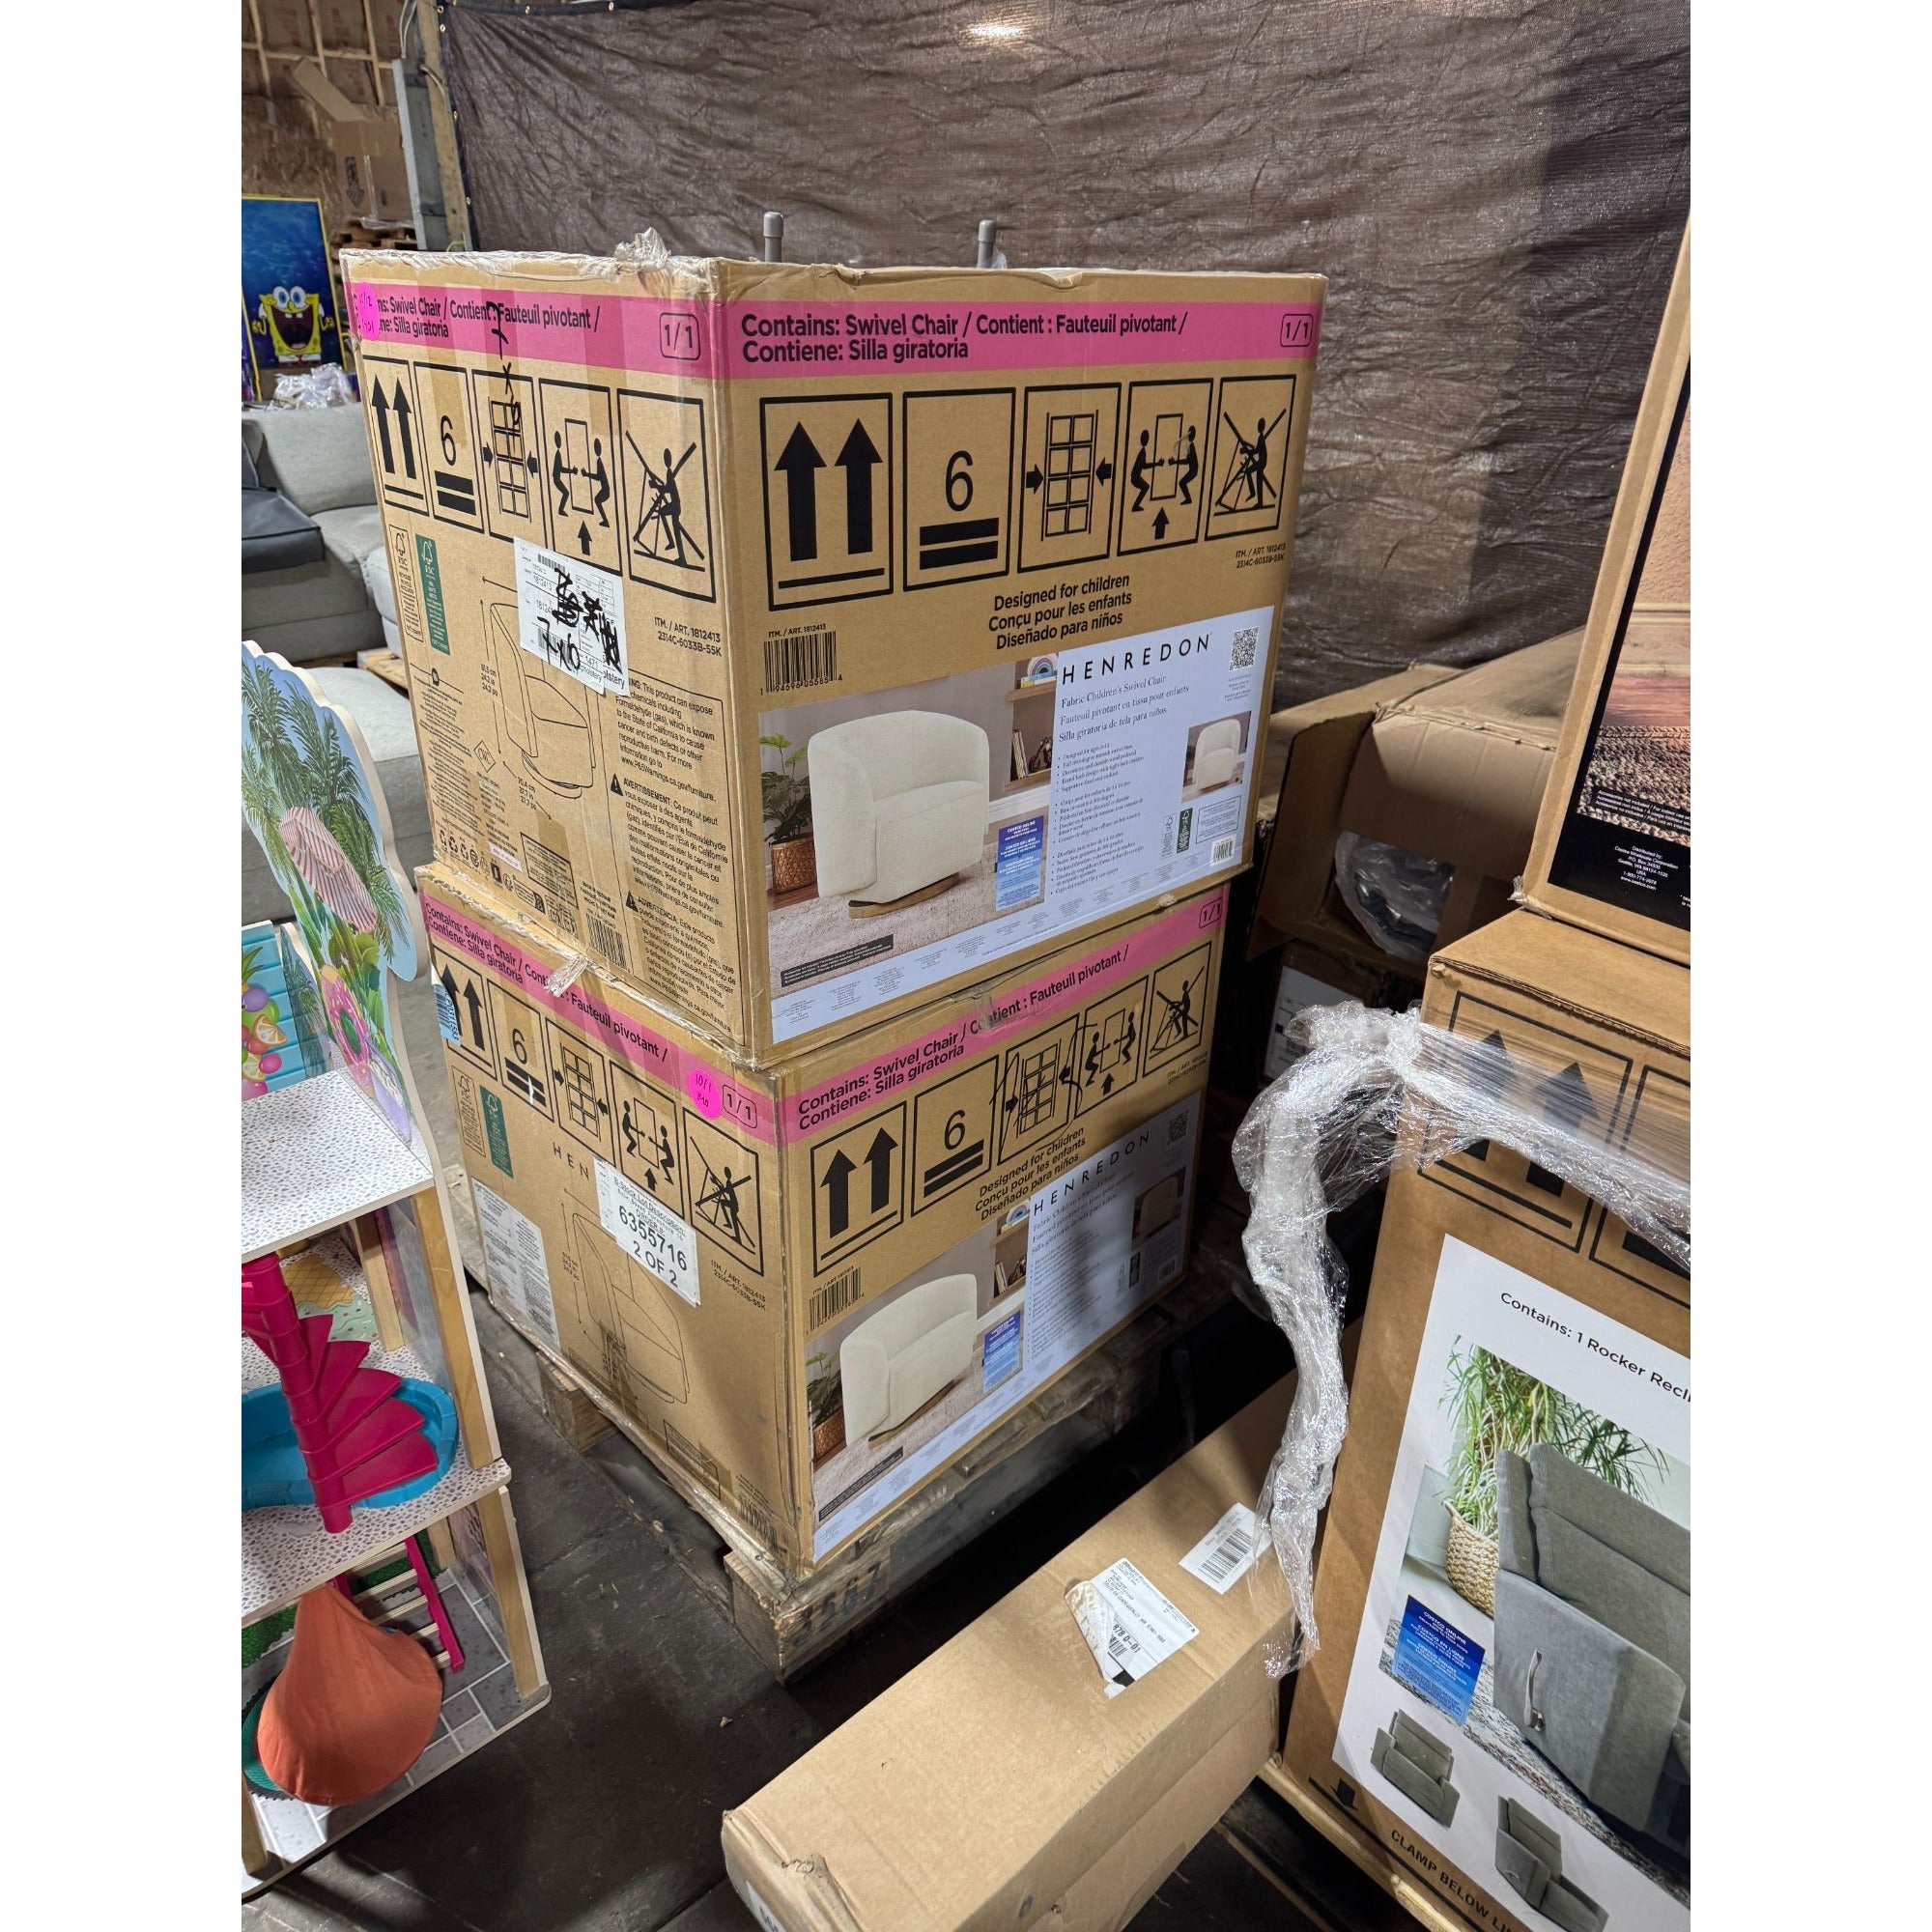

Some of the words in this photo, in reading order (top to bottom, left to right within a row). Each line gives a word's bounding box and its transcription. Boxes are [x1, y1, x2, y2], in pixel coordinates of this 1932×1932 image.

[389, 297, 417, 315] Swivel
[418, 298, 440, 317] Chair
[450, 299, 491, 321] Contient
[499, 302, 541, 325] Fauteuil
[543, 307, 591, 328] pivotant
[394, 317, 411, 333] Silla
[412, 320, 449, 338] giratoria
[742, 313, 839, 336] Contains:
[845, 313, 907, 336] Swivel
[912, 313, 958, 335] Chair
[977, 314, 1044, 334] Contient
[1056, 313, 1117, 334] Fauteuil
[1120, 313, 1177, 336] pivotant
[743, 340, 843, 363] Contiene:
[849, 338, 888, 361] Silla
[893, 338, 968, 364] giratoria
[946, 449, 974, 513] 6
[988, 611, 1031, 631] Conçu
[1035, 607, 1065, 627] pour
[1067, 601, 1085, 616] les
[1089, 592, 1132, 611] enfants
[994, 585, 1057, 611] Designed
[1060, 582, 1078, 598] for
[1081, 575, 1130, 595] children
[655, 616, 668, 630] ITM.
[673, 621, 690, 637] ART.
[691, 627, 722, 643] 1812413
[997, 625, 1058, 649] Diseñado
[1061, 620, 1088, 639] para
[1091, 611, 1122, 630] niños
[1062, 634, 1209, 685] HENREDON
[1061, 709, 1091, 725] Fauteuil
[1092, 703, 1121, 721] pivotant
[1132, 696, 1148, 708] tissu
[1149, 693, 1165, 705] pour
[1166, 686, 1189, 698] enfants
[1062, 694, 1086, 708] Fabric
[1086, 686, 1122, 703] Children's
[1123, 680, 1147, 695] Swivel
[1149, 674, 1167, 688] Chair
[1059, 727, 1075, 742] Silla
[1076, 722, 1108, 740] giratoria
[428, 920, 466, 949] Contiene:
[467, 938, 486, 960] Silla
[487, 951, 524, 984] giratoria
[425, 901, 463, 935] Contains:
[464, 921, 493, 952] Swivel
[494, 938, 516, 967] Chair
[570, 994, 611, 1029] Fauteuil
[613, 1017, 661, 1056] pivotant
[798, 1074, 869, 1114] Contains:
[873, 1048, 919, 1081] Swivel
[923, 1032, 958, 1056] Chair
[971, 1000, 1021, 1035] Ctient
[1029, 973, 1076, 1006] Fauteuil
[1078, 951, 1122, 985] pivotant
[799, 1090, 871, 1130] Contiene:
[875, 1073, 904, 1094] Silla
[908, 1042, 964, 1082] giratoria
[975, 1185, 1009, 1213] Conçu
[1010, 1172, 1036, 1192] pour
[1037, 1159, 1050, 1176] les
[1051, 1137, 1086, 1163] enfants
[980, 1159, 1028, 1197] Designed
[1030, 1151, 1044, 1169] for
[1046, 1126, 1084, 1155] children
[980, 1187, 1029, 1221] Diseñado
[1031, 1173, 1053, 1193] para
[1054, 1153, 1079, 1175] niños
[1035, 1130, 1151, 1216] HENREDON
[619, 1206, 687, 1271] 6355716
[633, 1240, 641, 1259] 2
[645, 1251, 665, 1274] OF
[669, 1269, 678, 1289] 2
[1500, 1293, 1573, 1338] Contains:
[1587, 1338, 1646, 1376] Rocker
[1391, 1830, 1437, 1873] CLAMP
[1440, 1870, 1490, 1918] BELOW
